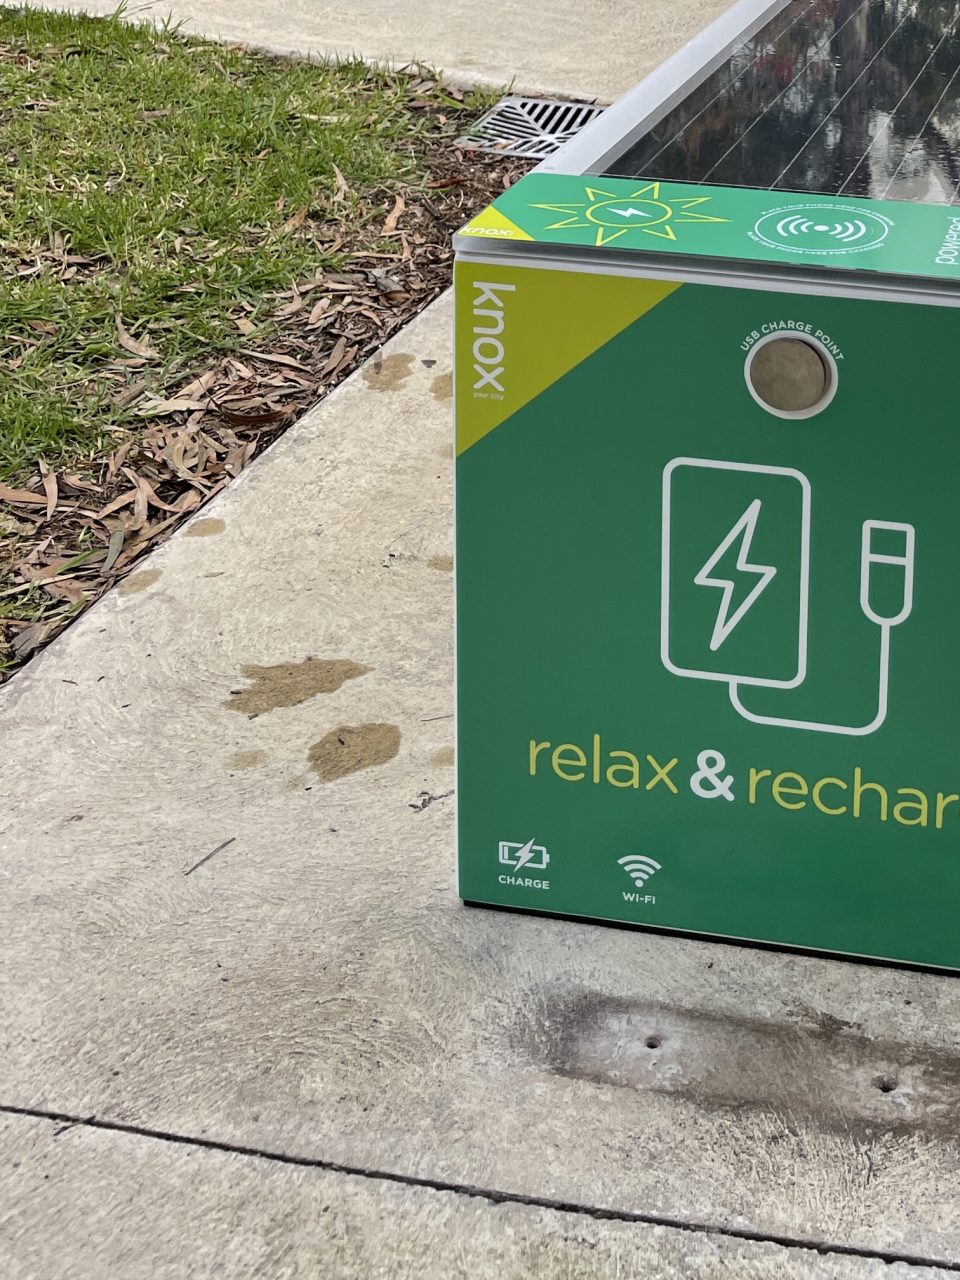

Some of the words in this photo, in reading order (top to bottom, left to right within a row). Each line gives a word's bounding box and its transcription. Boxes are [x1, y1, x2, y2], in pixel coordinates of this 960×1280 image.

[472, 281, 516, 391] knox
[740, 330, 760, 351] USB
[761, 320, 813, 334] CHARGE
[814, 330, 844, 361] POINT
[528, 733, 679, 795] relax
[689, 748, 735, 802] &
[498, 875, 550, 889] CHARGE
[622, 891, 656, 905] WI-FI
